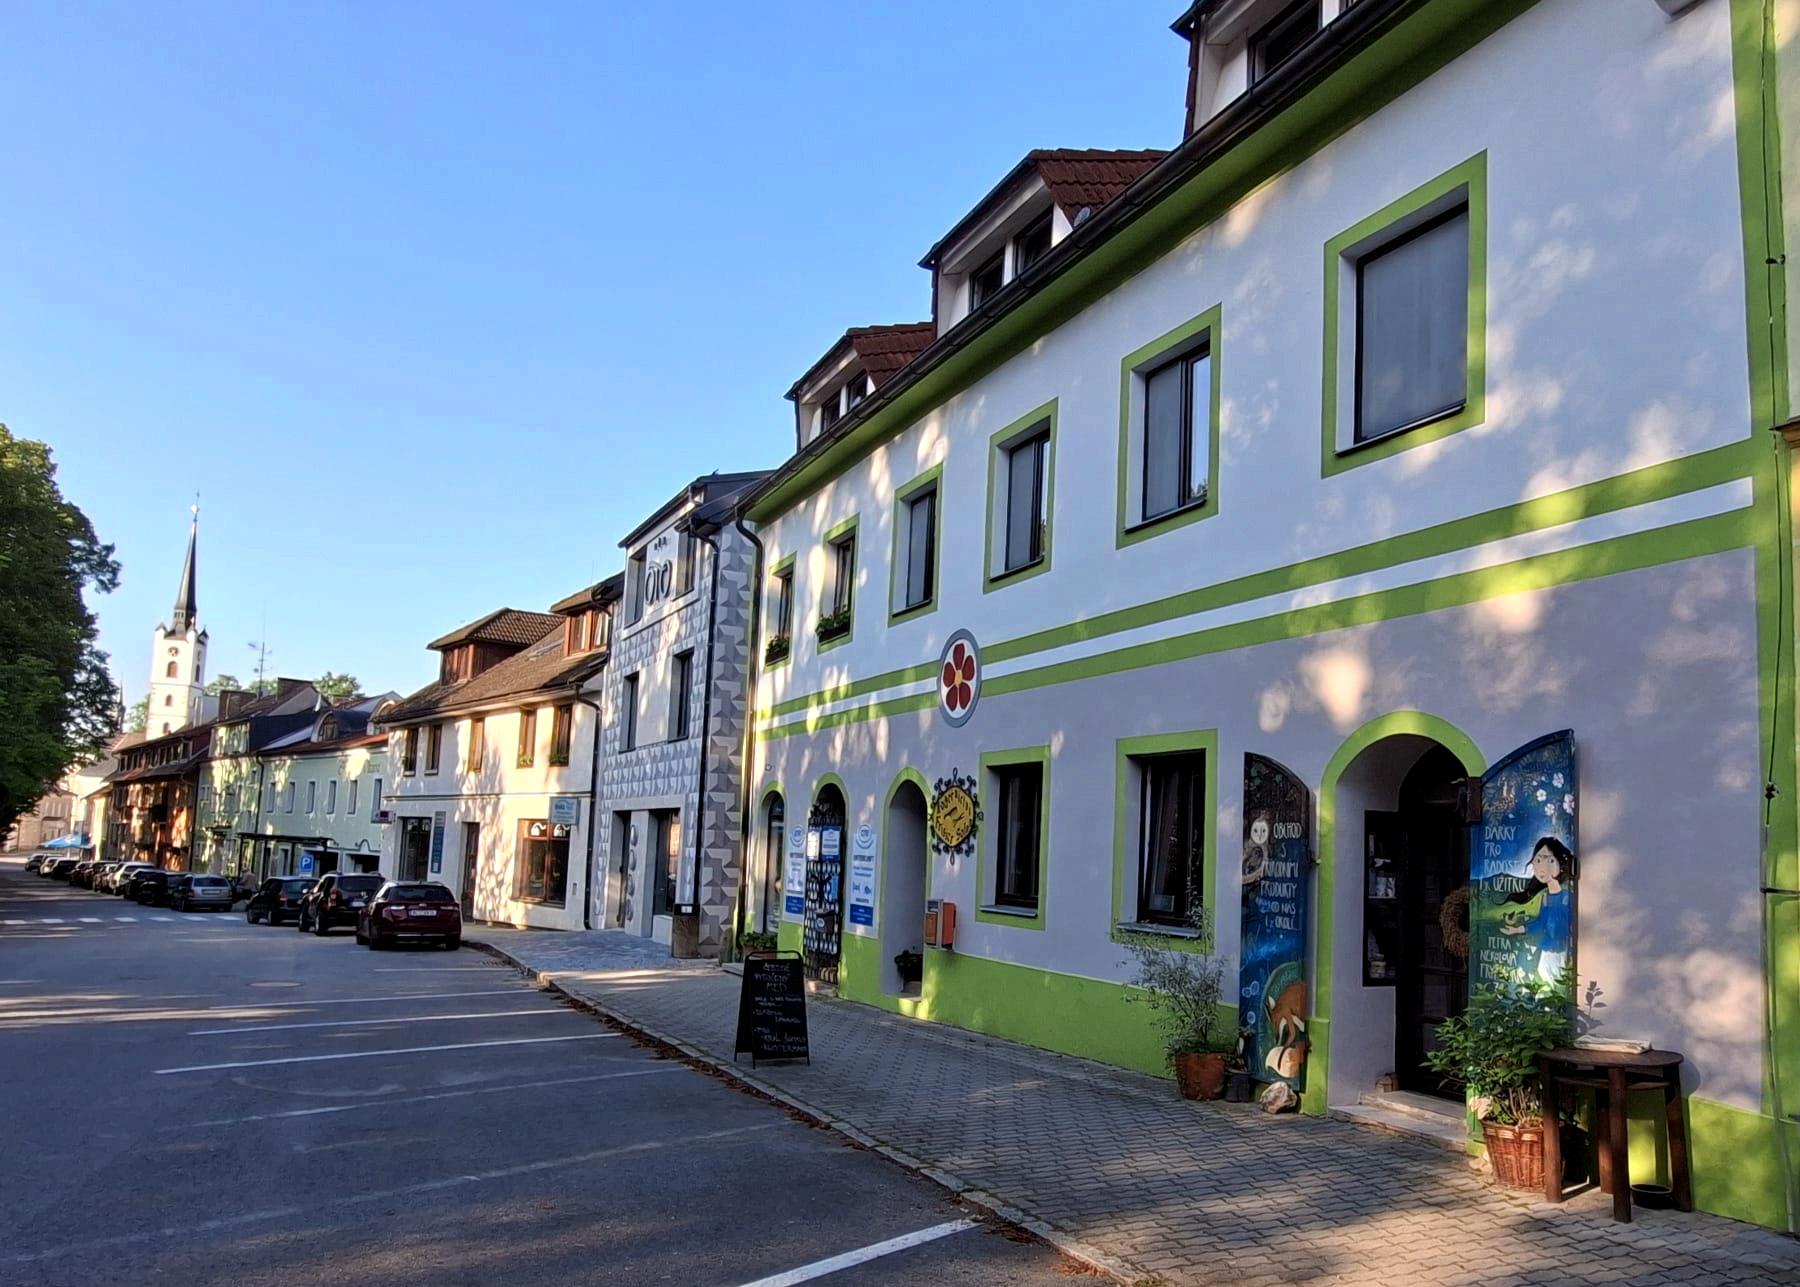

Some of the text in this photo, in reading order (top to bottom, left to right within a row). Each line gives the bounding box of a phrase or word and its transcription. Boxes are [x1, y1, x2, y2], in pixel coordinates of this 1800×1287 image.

[1273, 822, 1302, 839] OBCHOD
[1484, 842, 1502, 858] PRO
[1260, 880, 1298, 898] PRODUKTY
[1488, 936, 1512, 950] PETRA
